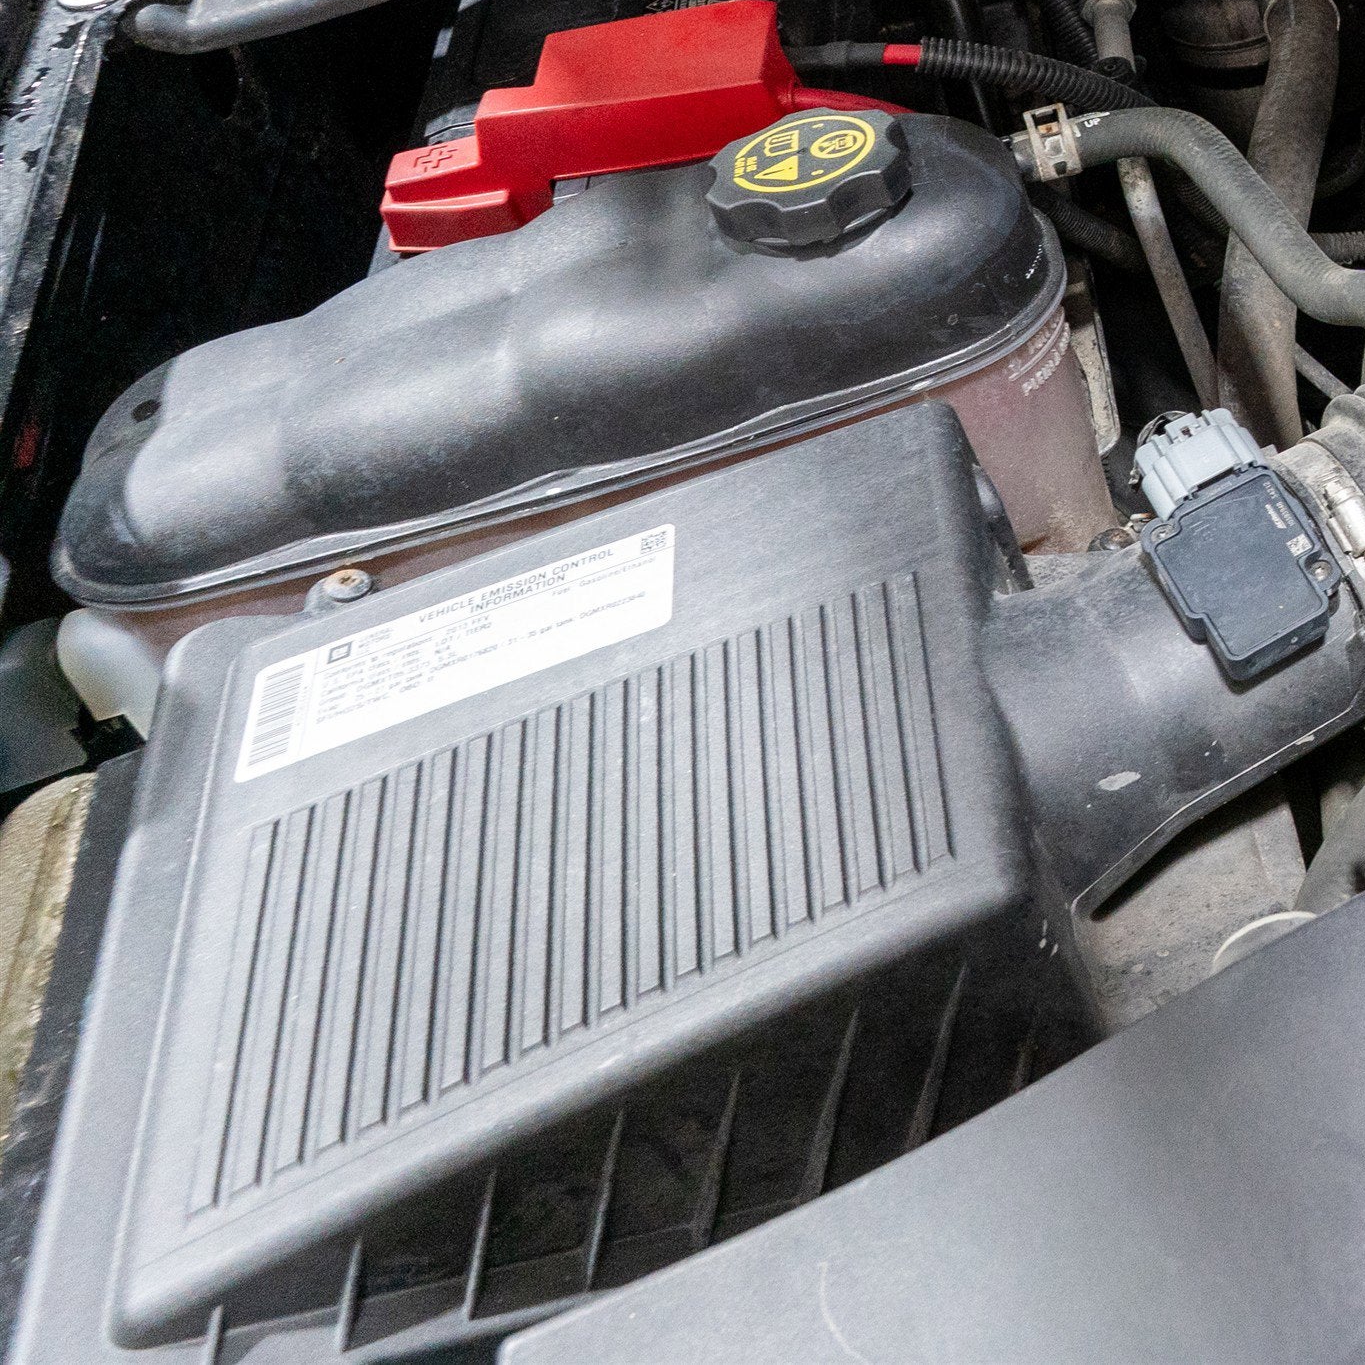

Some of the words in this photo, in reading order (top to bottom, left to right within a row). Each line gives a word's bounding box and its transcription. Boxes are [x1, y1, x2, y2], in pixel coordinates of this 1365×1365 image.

[1084, 118, 1101, 128] UP
[418, 595, 475, 624] VEHICLE
[480, 570, 546, 601] EMISSION
[552, 546, 614, 576] CONTROL
[470, 572, 565, 614] INFORMATION
